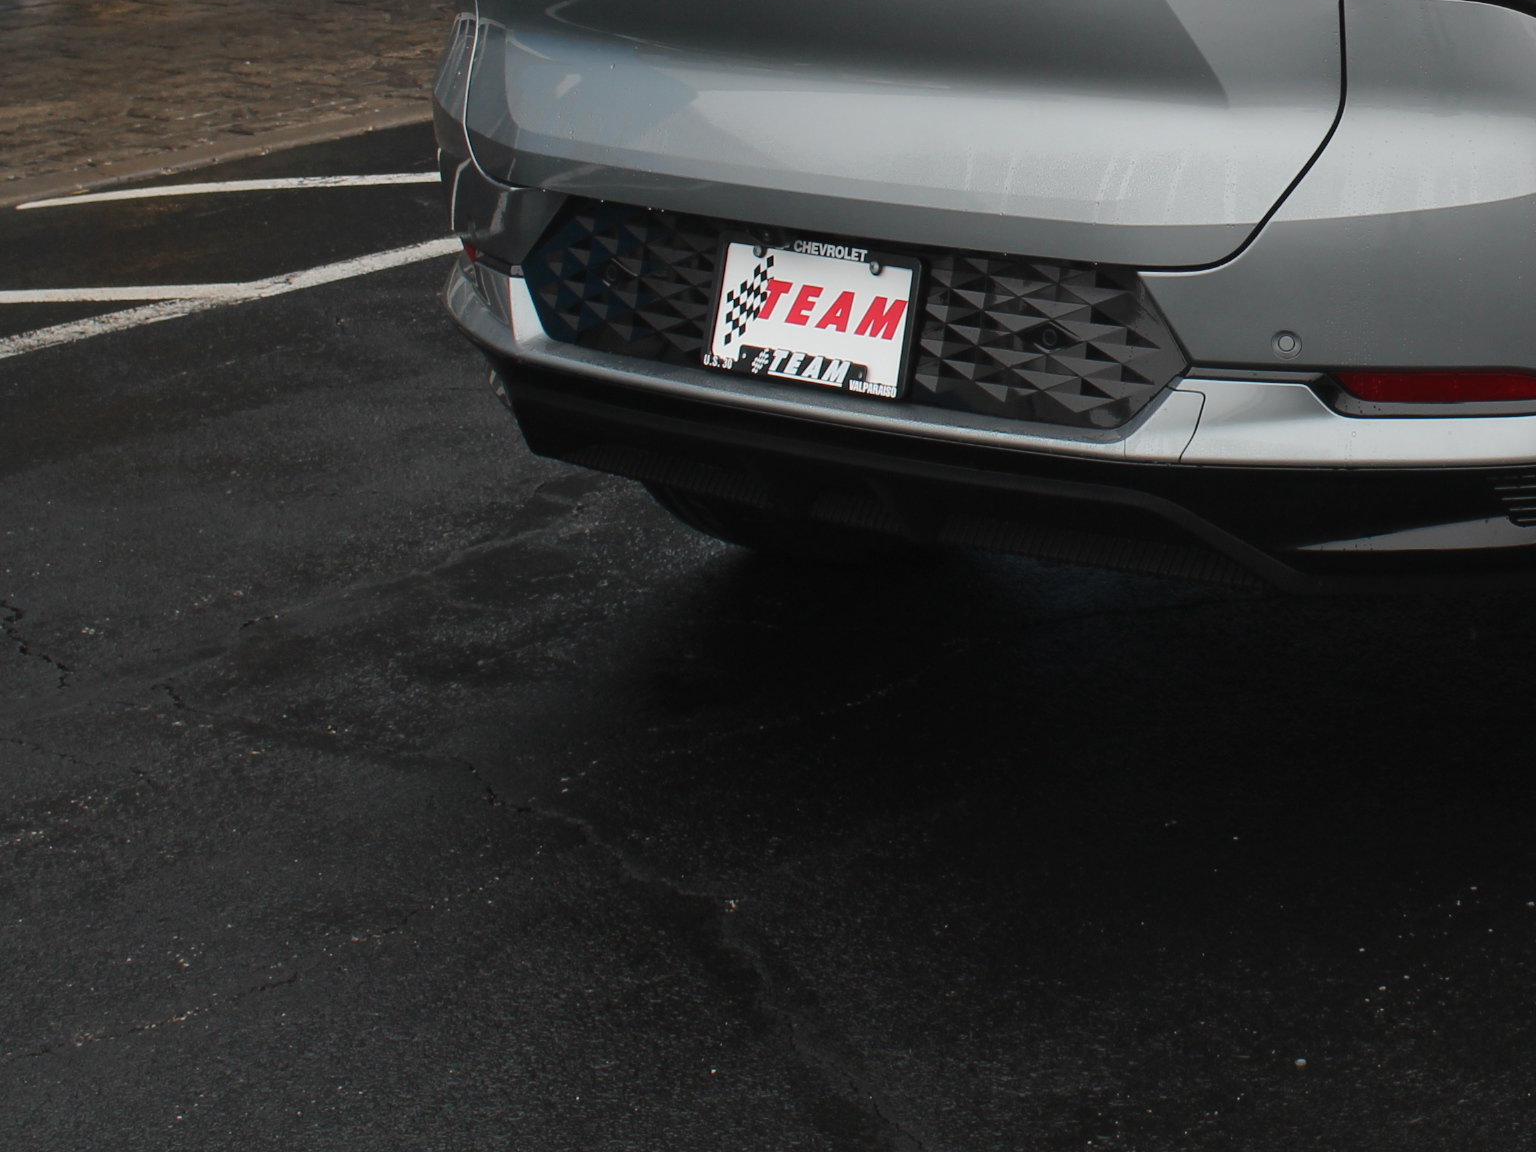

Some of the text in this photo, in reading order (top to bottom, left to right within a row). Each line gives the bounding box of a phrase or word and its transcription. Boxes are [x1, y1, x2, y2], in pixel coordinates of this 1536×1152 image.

[793, 239, 868, 263] CHEVROLET
[757, 279, 908, 341] TEAM
[703, 354, 733, 370] U.S. 30
[768, 349, 850, 384] TEAM
[849, 379, 897, 399] VALPARAISO
